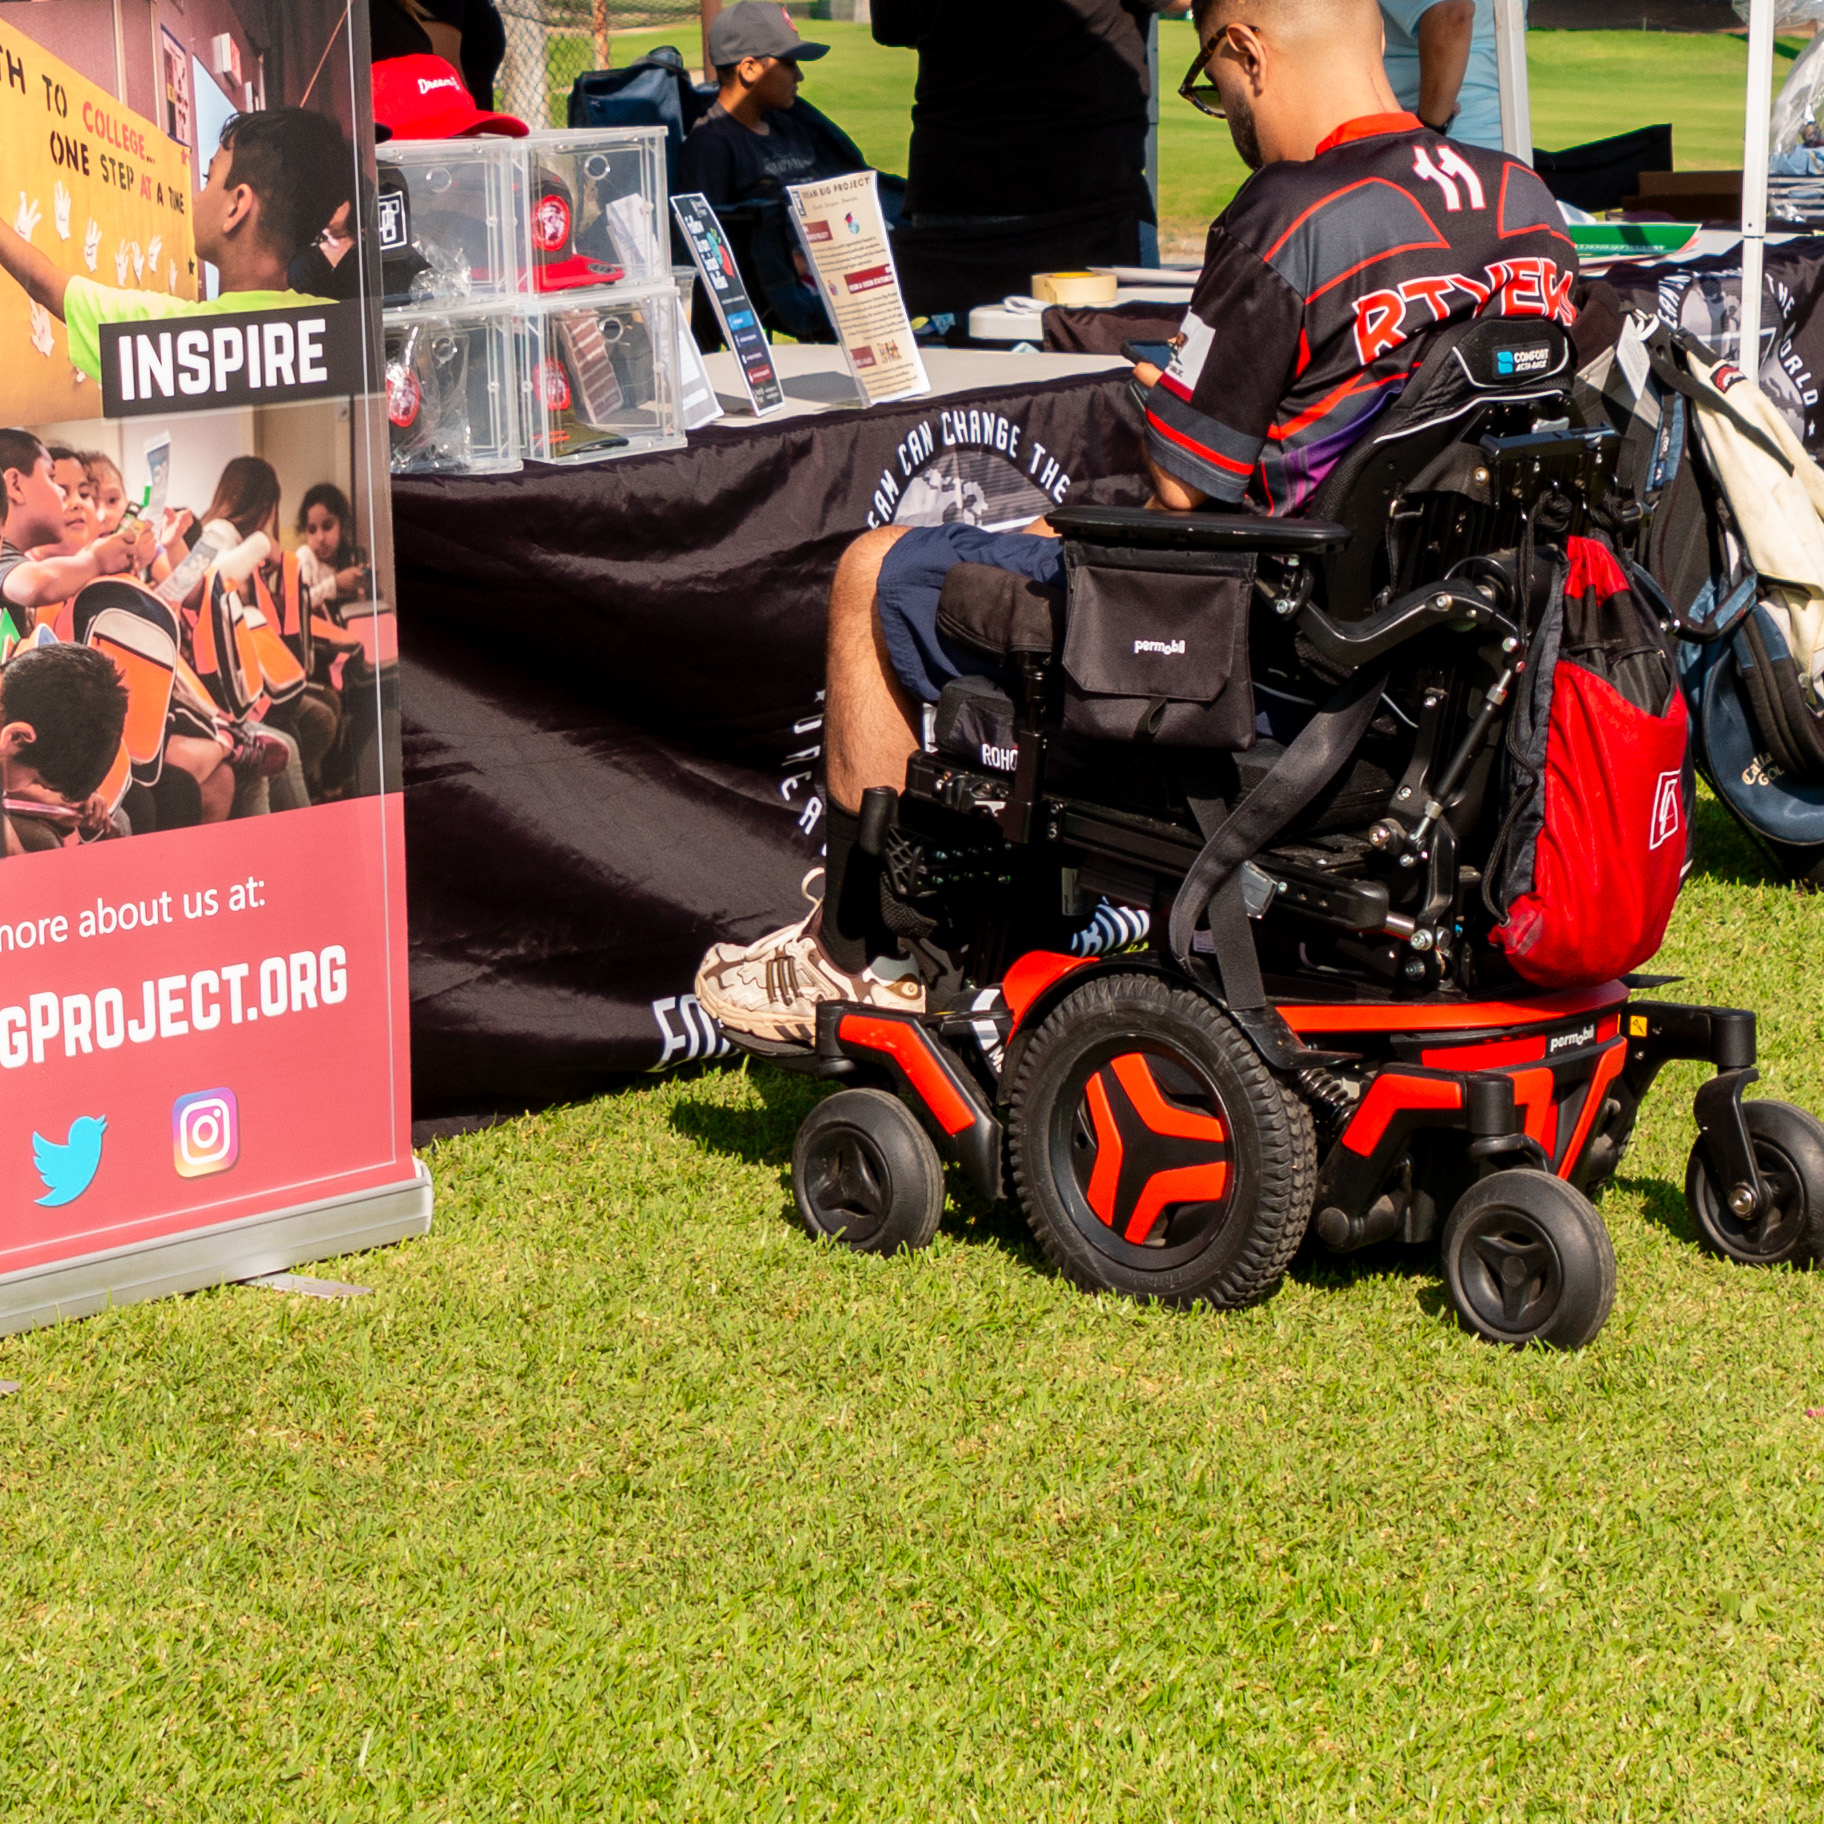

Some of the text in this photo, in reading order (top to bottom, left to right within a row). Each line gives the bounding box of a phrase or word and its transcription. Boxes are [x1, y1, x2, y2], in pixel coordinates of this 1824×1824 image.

[42, 74, 68, 119] TO
[49, 130, 186, 215] ONE STEP AT A TIME
[833, 176, 871, 193] PROJECT
[118, 317, 329, 403] INSPIRE
[1779, 322, 1819, 407] ORLD
[866, 409, 1071, 529] EAM CAN CHANGE THE
[1133, 639, 1186, 655] permobil
[1741, 752, 1774, 786] Calla
[1757, 766, 1785, 787] GOL
[77, 890, 174, 941] about
[182, 882, 220, 920] us
[227, 875, 267, 912] at:
[1549, 1023, 1595, 1053] permobil
